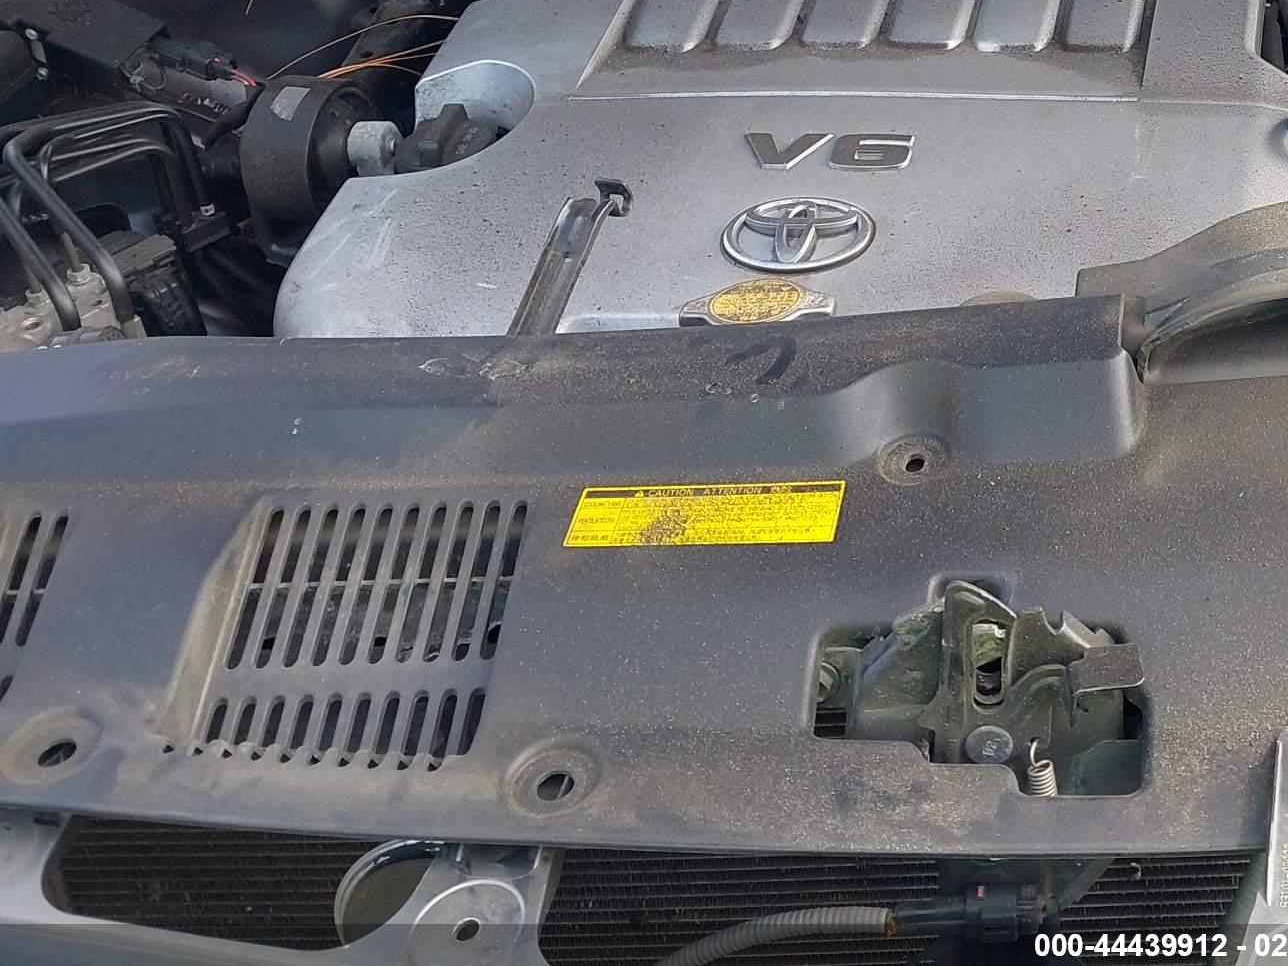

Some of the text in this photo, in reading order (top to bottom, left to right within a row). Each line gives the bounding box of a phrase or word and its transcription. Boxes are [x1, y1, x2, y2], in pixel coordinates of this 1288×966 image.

[743, 131, 916, 171] V6
[648, 489, 694, 497] CAUTION
[703, 487, 762, 495] ATTENTION
